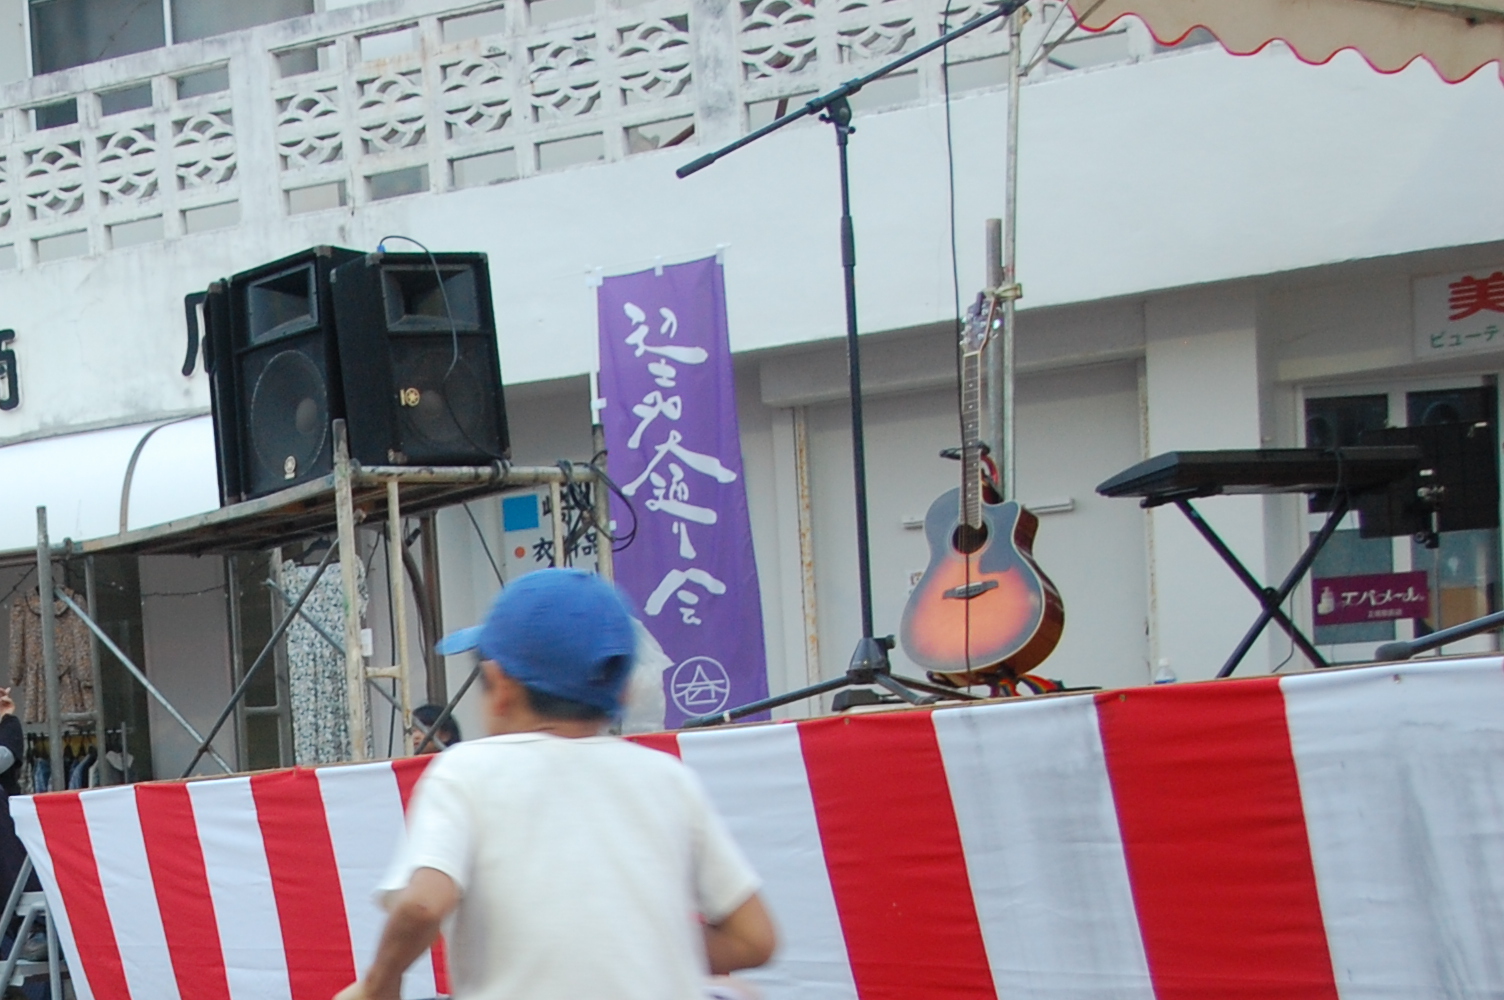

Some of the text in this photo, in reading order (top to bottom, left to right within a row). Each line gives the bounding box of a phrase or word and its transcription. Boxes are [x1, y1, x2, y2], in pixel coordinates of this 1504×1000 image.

[1429, 324, 1504, 349] ビューテ
[1340, 586, 1420, 607] エパメール
